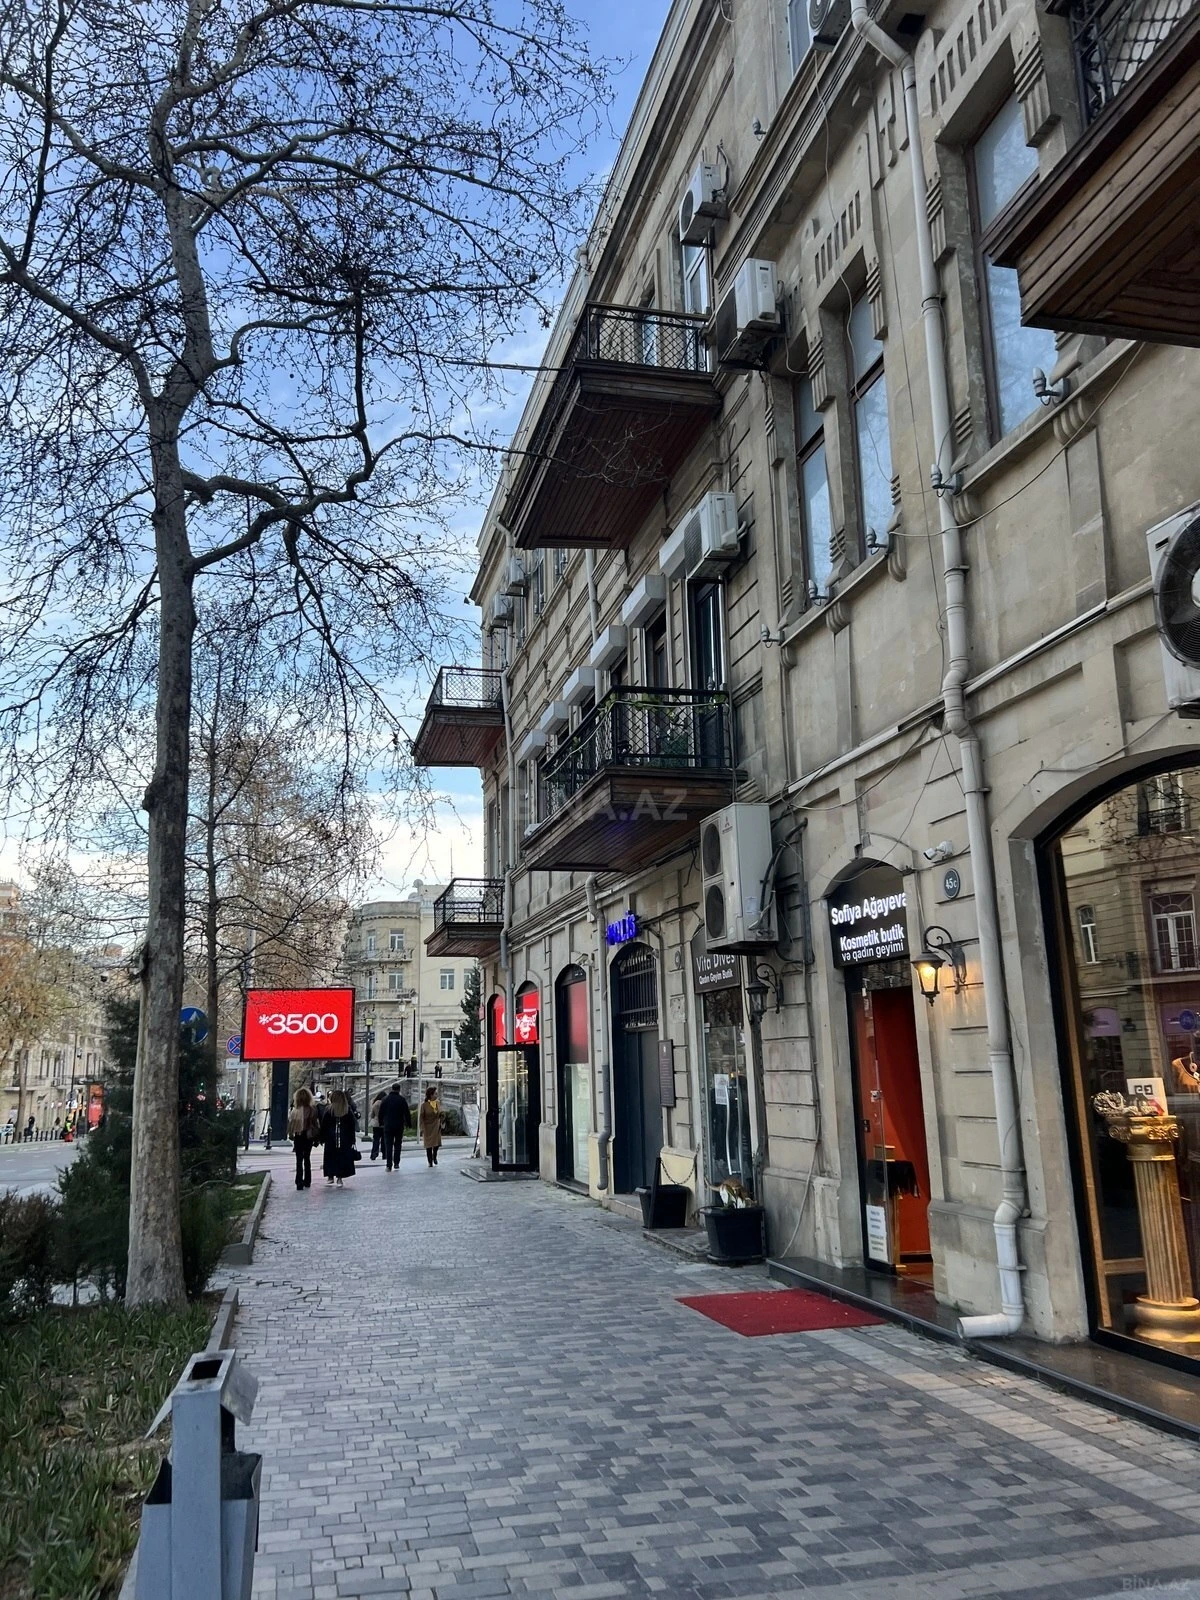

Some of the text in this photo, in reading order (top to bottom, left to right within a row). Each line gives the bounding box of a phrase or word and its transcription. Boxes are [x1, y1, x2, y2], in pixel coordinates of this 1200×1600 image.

[831, 892, 907, 925] Sofiya Ağayeva
[840, 923, 905, 952] Kosmetik butik
[842, 939, 904, 962] və qadın geyimi
[696, 955, 711, 972] Vita
